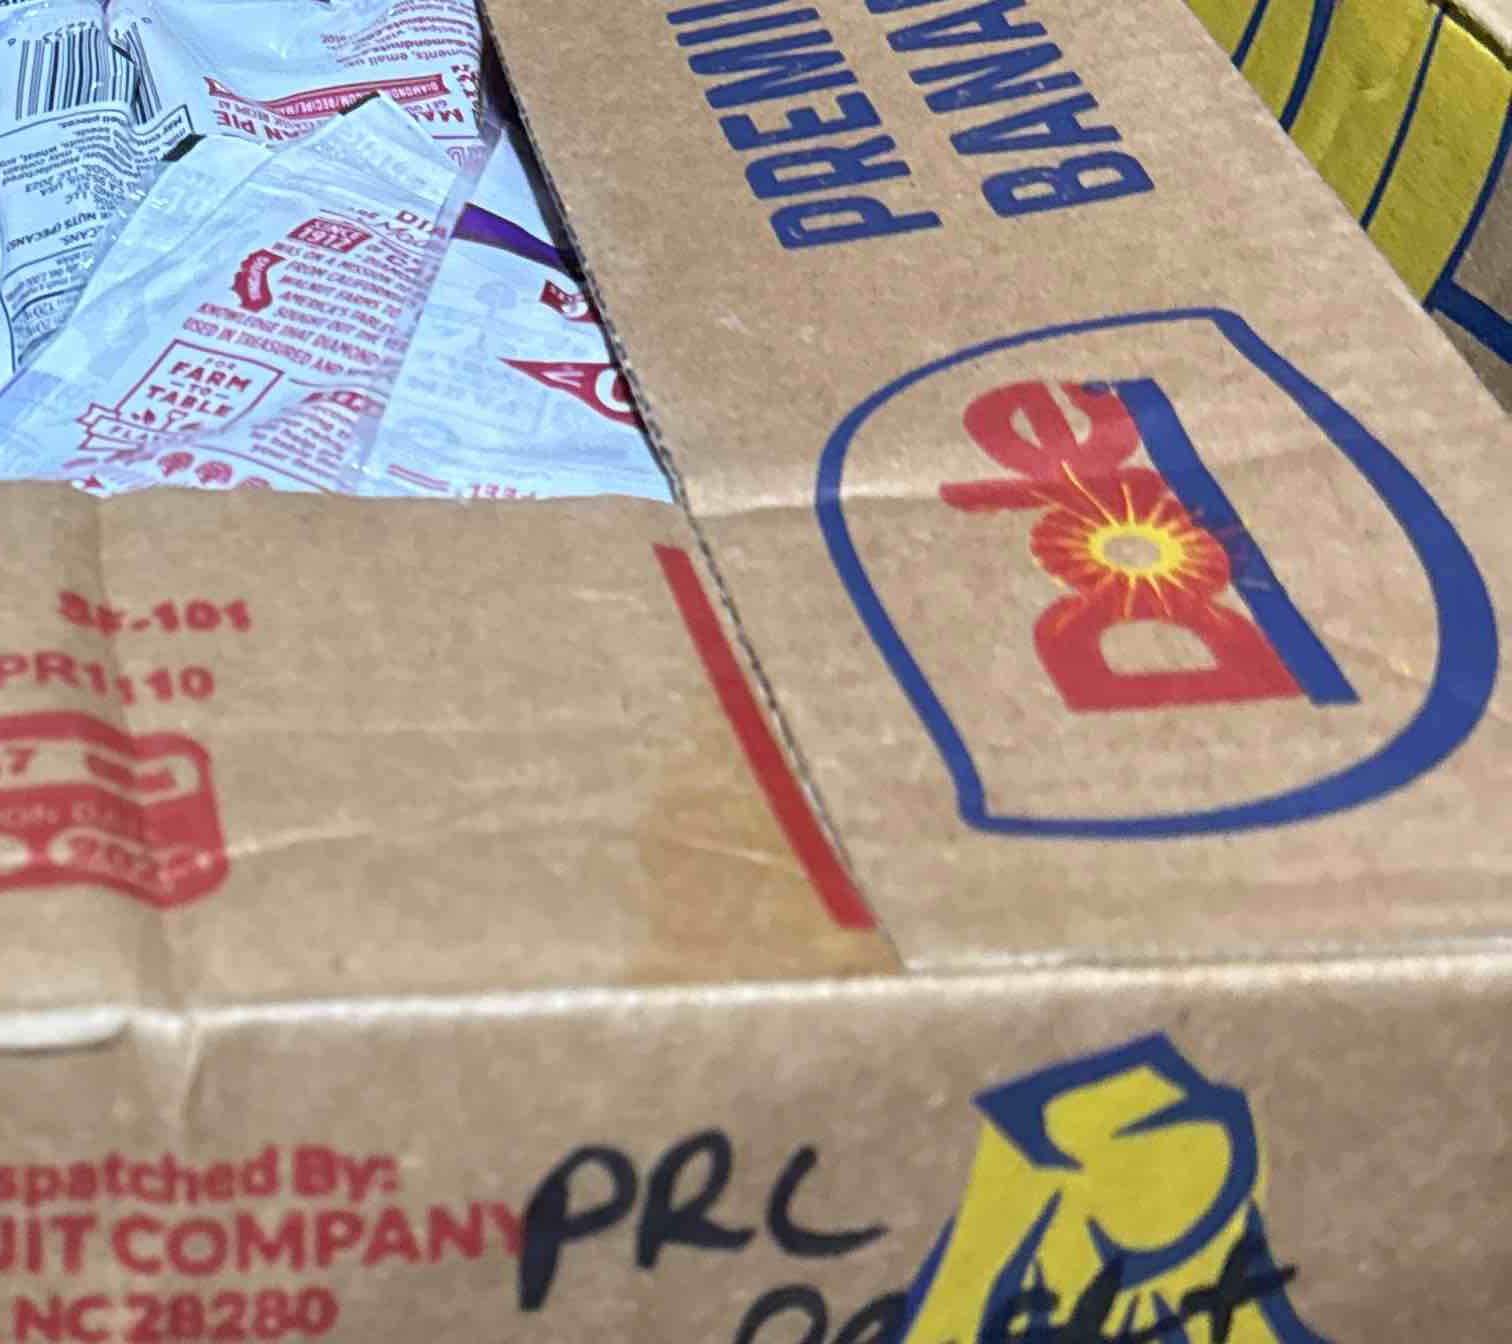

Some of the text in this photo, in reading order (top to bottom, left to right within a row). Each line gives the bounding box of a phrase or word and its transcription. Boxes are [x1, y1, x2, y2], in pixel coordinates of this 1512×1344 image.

[144, 383, 236, 418] TABLE
[169, 359, 254, 393] FARM
[939, 378, 1306, 716] Dole
[292, 1145, 399, 1203] By:
[111, 1200, 526, 1278] COMPANY
